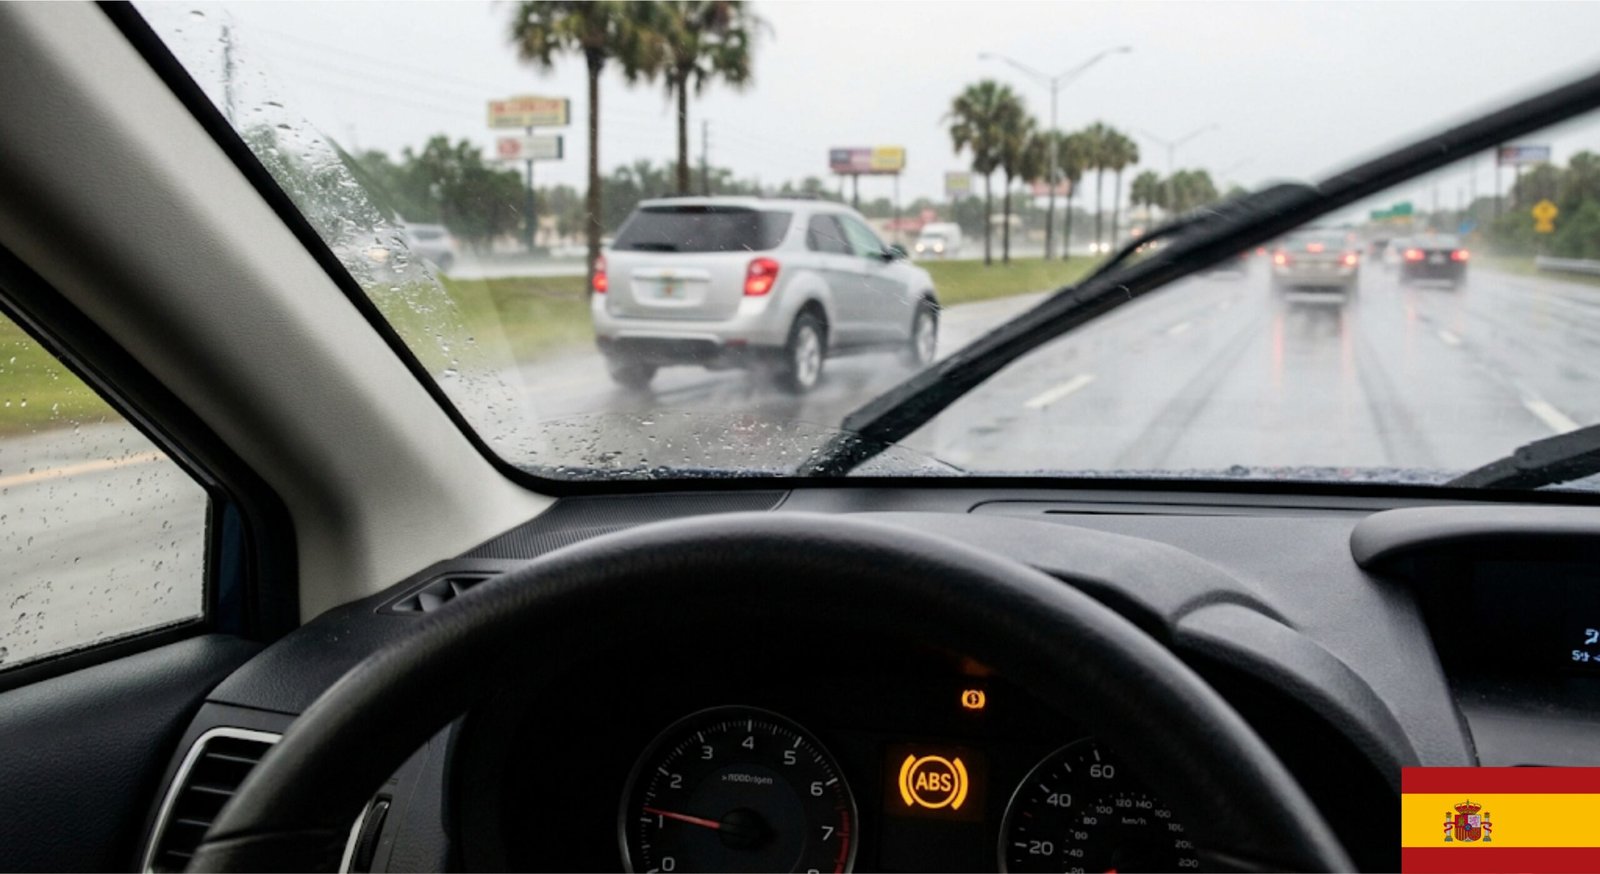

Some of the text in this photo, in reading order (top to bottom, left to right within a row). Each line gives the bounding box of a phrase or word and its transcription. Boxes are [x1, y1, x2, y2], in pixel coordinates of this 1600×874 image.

[741, 736, 755, 749] 4
[702, 746, 714, 760] 3
[783, 750, 797, 766] 5
[1089, 764, 1115, 779] 60
[669, 773, 683, 789] 2
[915, 771, 952, 792] ABS
[810, 781, 824, 797] 6
[1046, 793, 1072, 808] 40
[1115, 799, 1133, 808] 120
[1096, 805, 1113, 815] 100
[658, 813, 664, 829] 1
[1121, 816, 1147, 825] km/h
[821, 825, 835, 841] 7
[1028, 840, 1054, 856] 20
[1069, 848, 1084, 858] 40
[661, 856, 676, 872] 0
